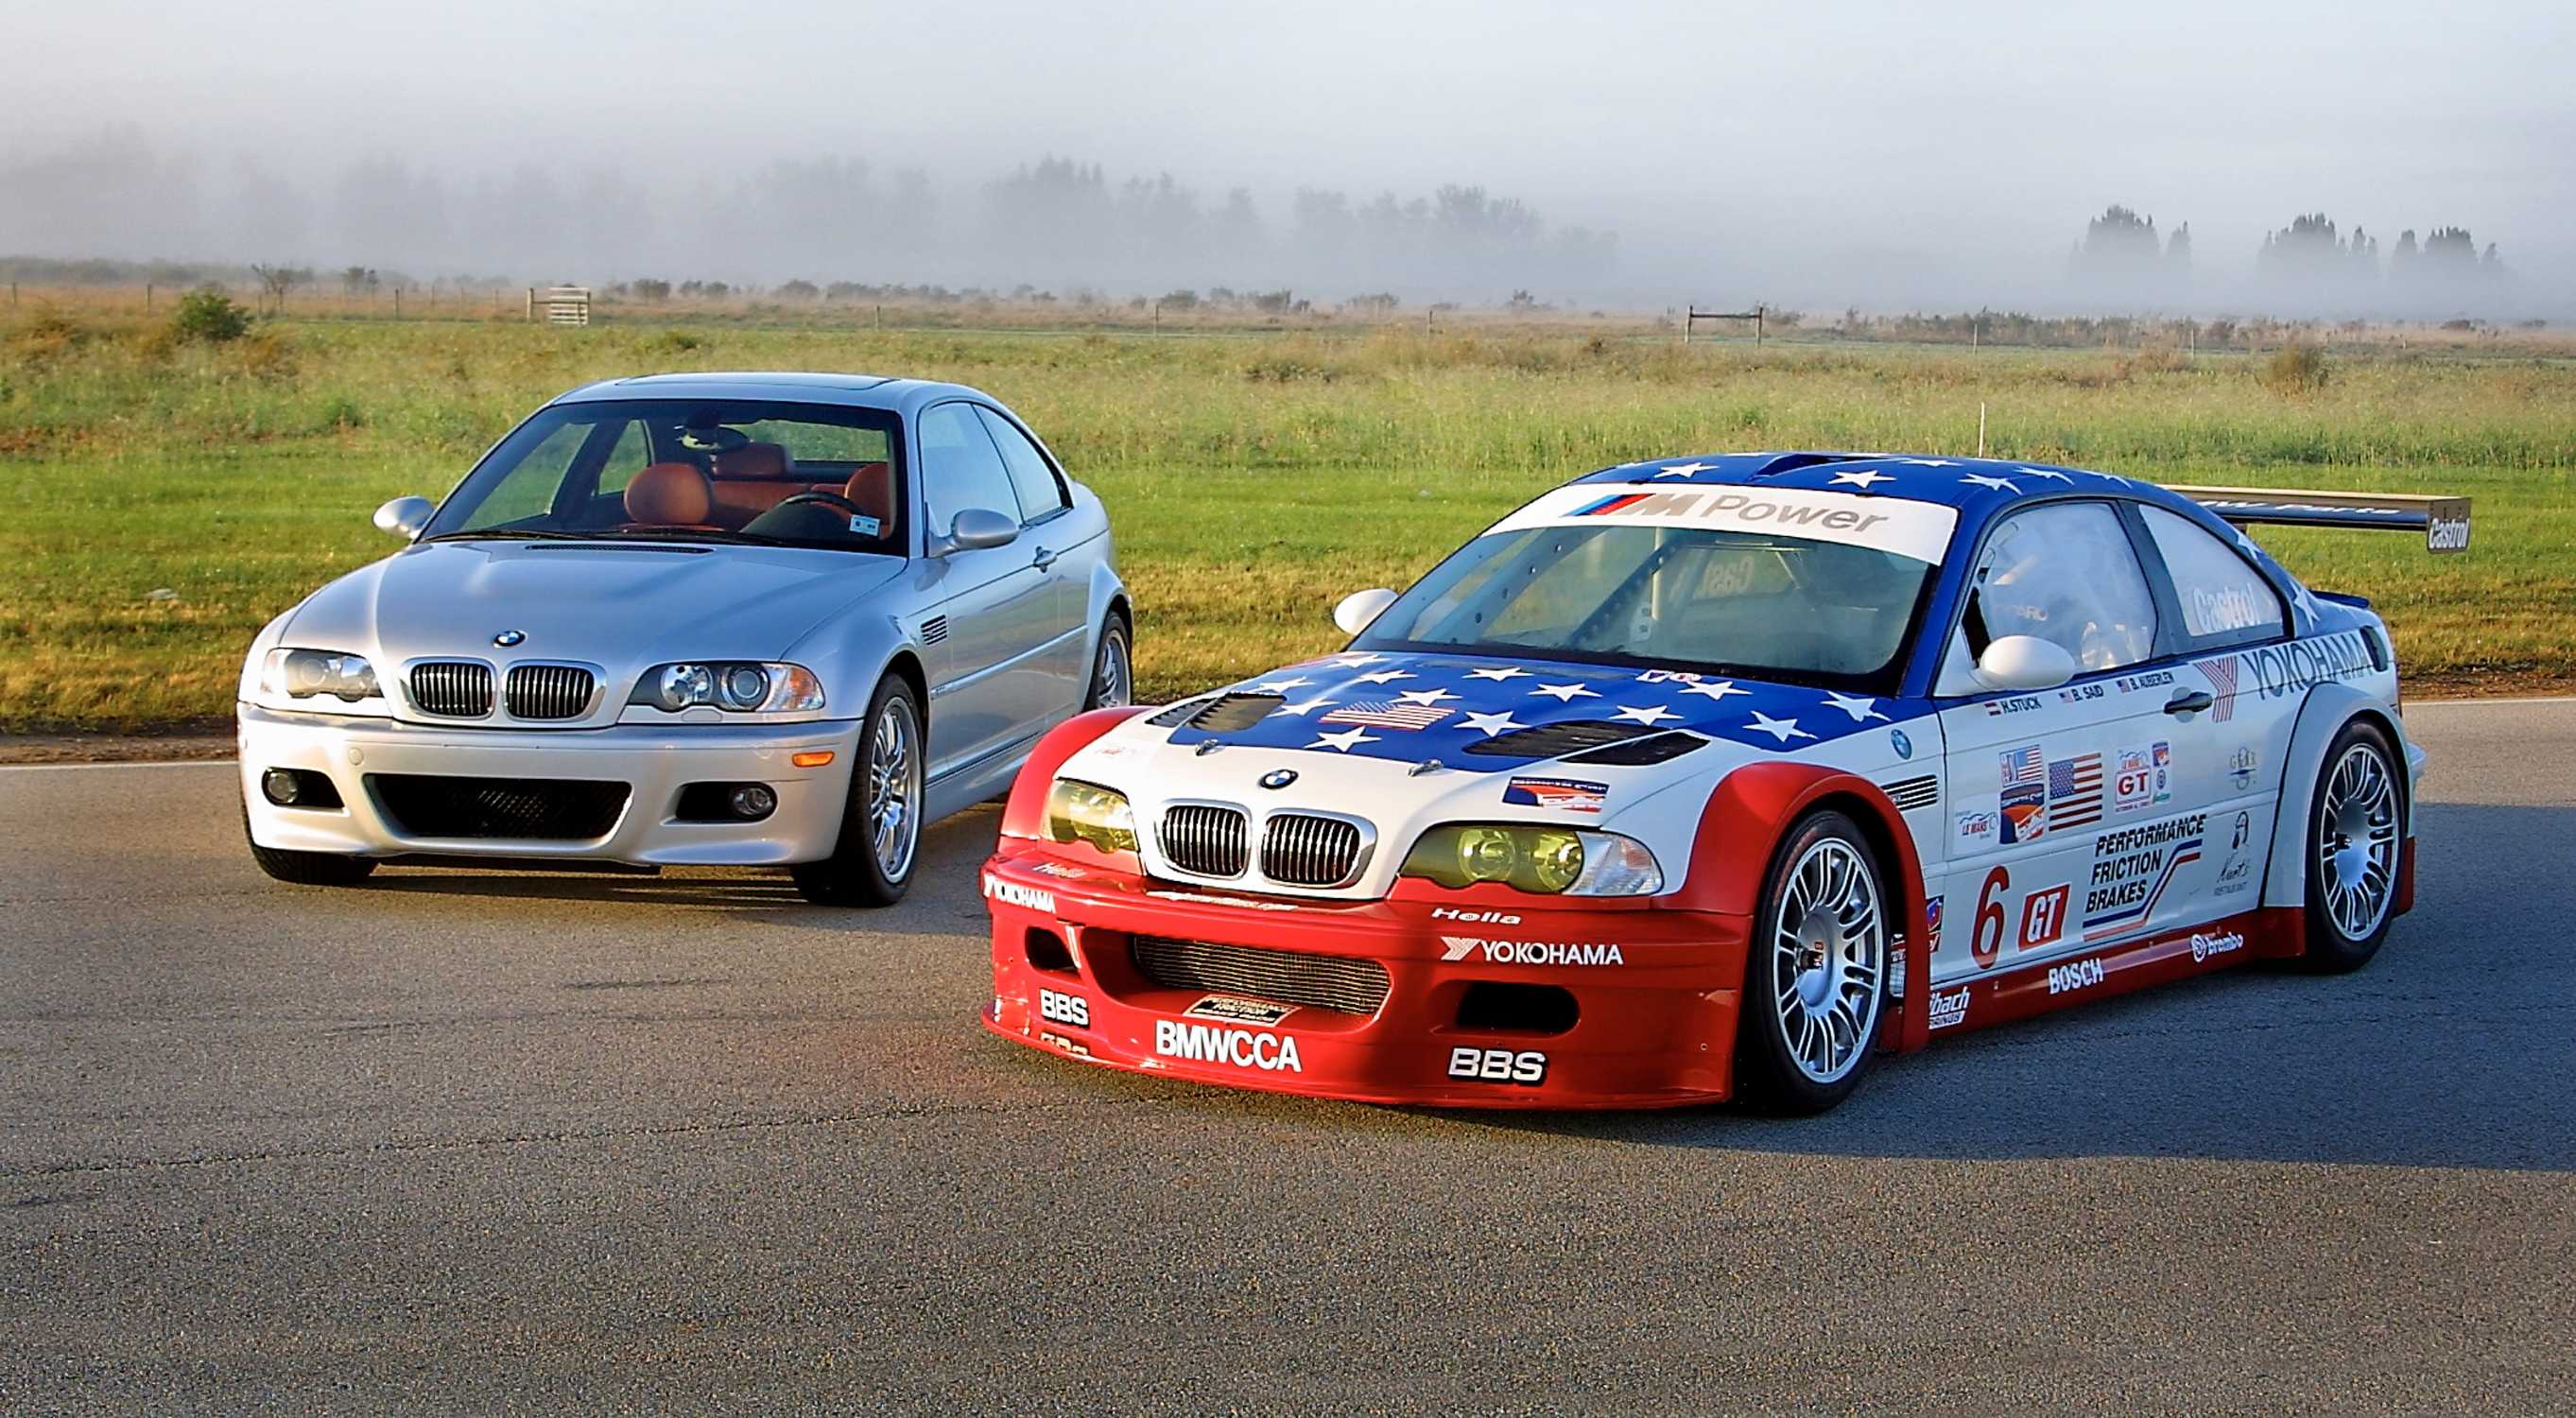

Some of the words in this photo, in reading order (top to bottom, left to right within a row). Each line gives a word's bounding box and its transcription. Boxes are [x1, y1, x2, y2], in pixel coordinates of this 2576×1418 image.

[1700, 494, 1890, 532] Power
[2429, 518, 2470, 548] Castrol
[2193, 581, 2261, 633] Castrol
[2241, 632, 2374, 700] YOKOHAMA
[2118, 771, 2149, 796] GT
[2095, 814, 2206, 857] PERFORMANCE
[2091, 849, 2163, 886] FRICTION
[993, 876, 1057, 914] YOKOHAMA
[2085, 879, 2147, 913] BRAKES
[1431, 908, 1522, 925] Hella
[1971, 864, 2011, 970] 6
[2027, 891, 2062, 942] GT
[1480, 941, 1624, 965] YOKOHAMA
[2204, 931, 2244, 955] brembo
[2049, 958, 2103, 994] BOSCH
[1040, 989, 1090, 1026] BBS
[1929, 986, 1970, 1016] ibach
[1156, 1020, 1302, 1072] BMWCCA
[1448, 1047, 1547, 1081] BBS
